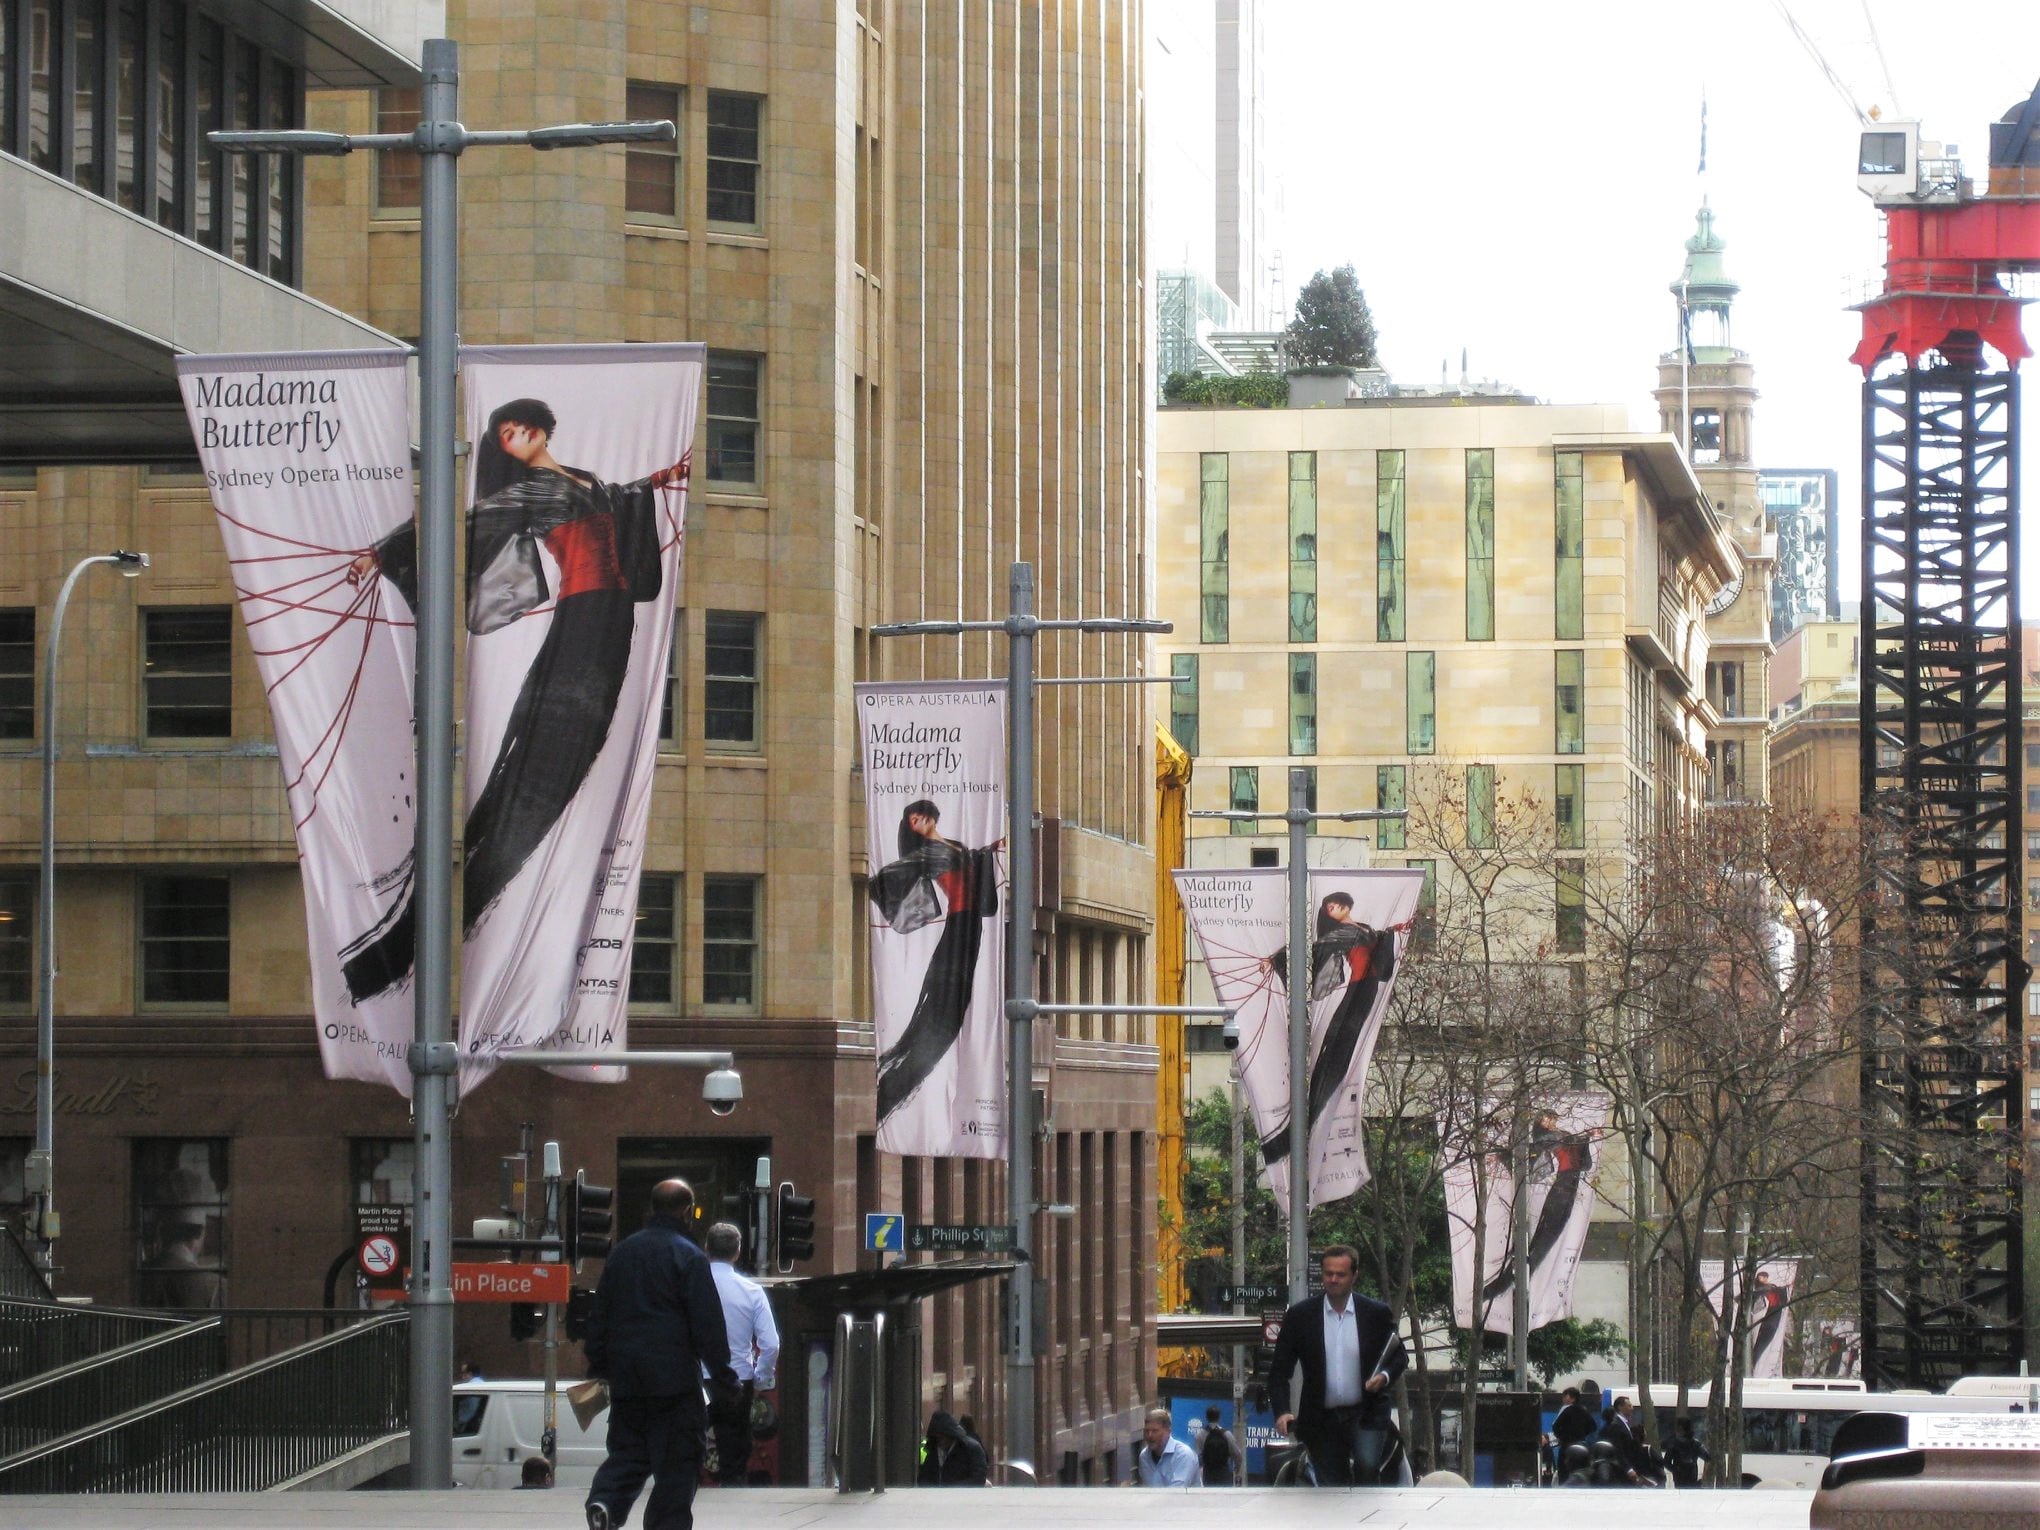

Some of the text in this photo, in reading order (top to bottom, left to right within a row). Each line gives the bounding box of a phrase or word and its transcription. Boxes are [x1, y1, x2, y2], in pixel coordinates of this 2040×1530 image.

[196, 373, 337, 408] Madama
[202, 411, 340, 453] Butterfly
[208, 464, 404, 490] Sydney Opera House
[870, 722, 962, 744] Madama
[872, 747, 962, 774] Butterfly
[873, 782, 999, 796] Sydney Opera House
[1183, 877, 1252, 892] Madama
[1188, 894, 1254, 912] Butterfly
[1227, 917, 1253, 927] Opera
[1256, 918, 1282, 927] House
[360, 1218, 380, 1226] proud
[932, 1228, 969, 1245] Phillip
[478, 1274, 532, 1293] Place
[1236, 1287, 1277, 1299] Phillip St
[1248, 1426, 1268, 1437] TRAIN
